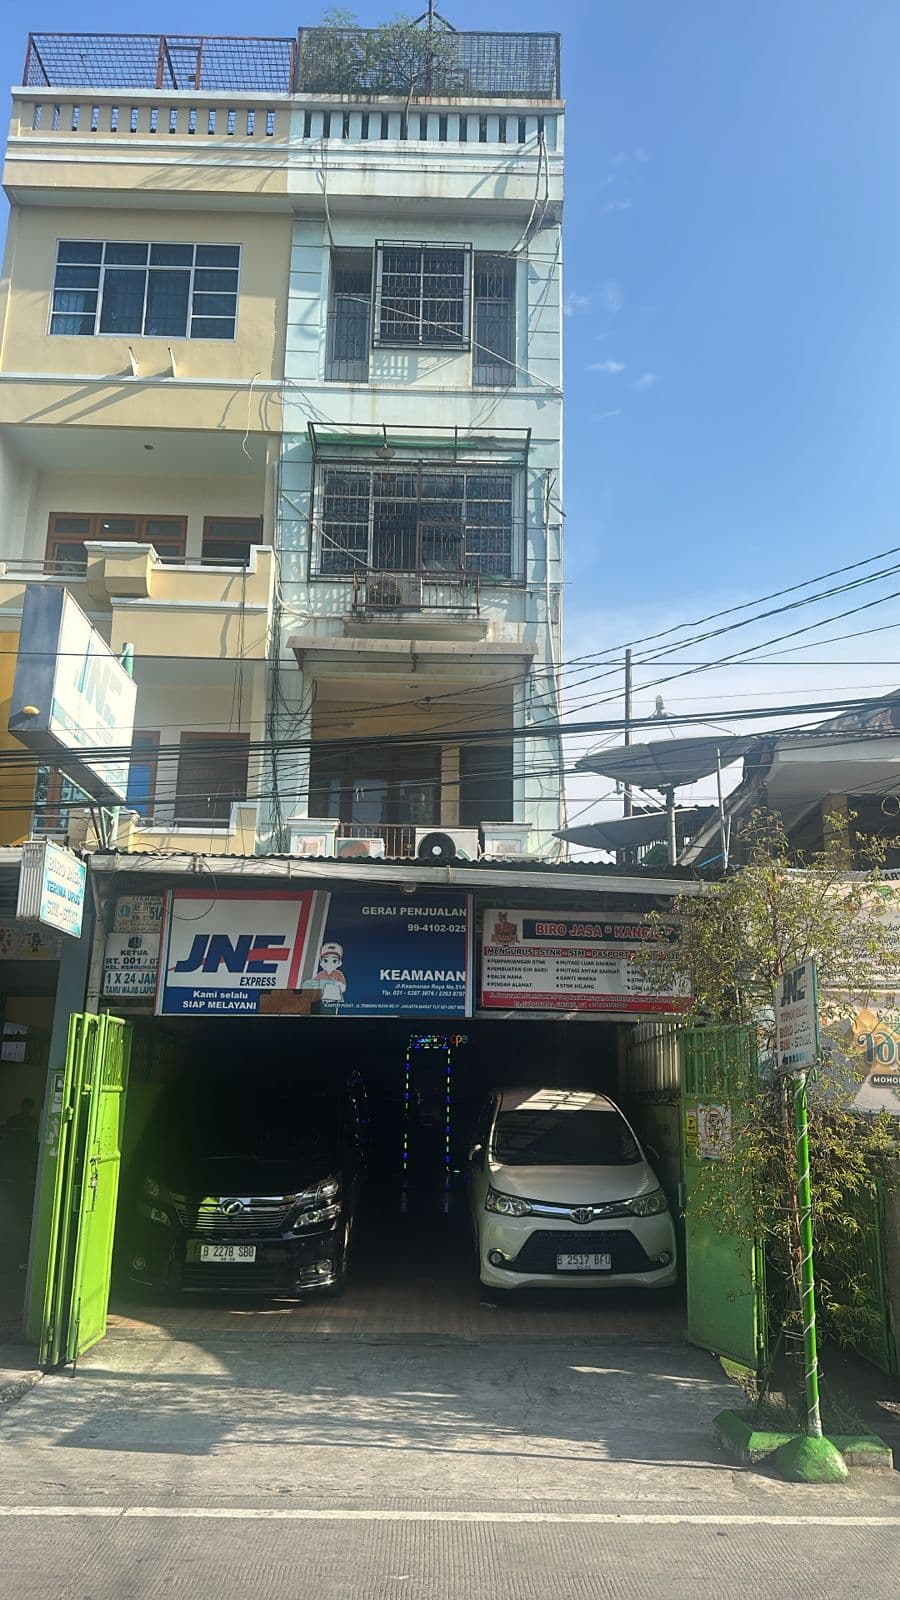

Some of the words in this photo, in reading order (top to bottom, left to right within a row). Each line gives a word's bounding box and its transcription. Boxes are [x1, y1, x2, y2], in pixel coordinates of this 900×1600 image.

[47, 879, 66, 899] TERIMA
[67, 886, 81, 905] URUS
[362, 906, 397, 916] GERAI
[400, 907, 467, 917] PENJUALAN
[407, 923, 467, 933] 99-4102-025
[535, 923, 566, 935] BIRO
[569, 924, 602, 937] JASA
[174, 934, 290, 974] JNE
[487, 947, 533, 956] MENGURUS
[540, 948, 561, 957] STNK
[569, 949, 585, 957] SIM
[592, 950, 629, 959] PASPORT
[105, 957, 119, 965] RT.
[123, 957, 141, 965] 001
[107, 973, 112, 985] 1
[115, 973, 122, 984] X
[125, 973, 136, 985] 24
[379, 969, 467, 982] KEAMANAN
[240, 976, 277, 987] EXPRESS
[105, 986, 120, 994] TAMU
[122, 986, 138, 994] WAJIB
[432, 983, 445, 992] Raya
[193, 990, 218, 999] Kami
[220, 990, 248, 999] selalu
[182, 1000, 205, 1009] SIAP
[207, 1001, 257, 1010] MELAYANI
[873, 1076, 900, 1084] MOHO
[203, 1246, 209, 1257] B
[213, 1246, 234, 1257] 2278
[557, 1255, 563, 1265] B
[567, 1254, 590, 1265] 2517
